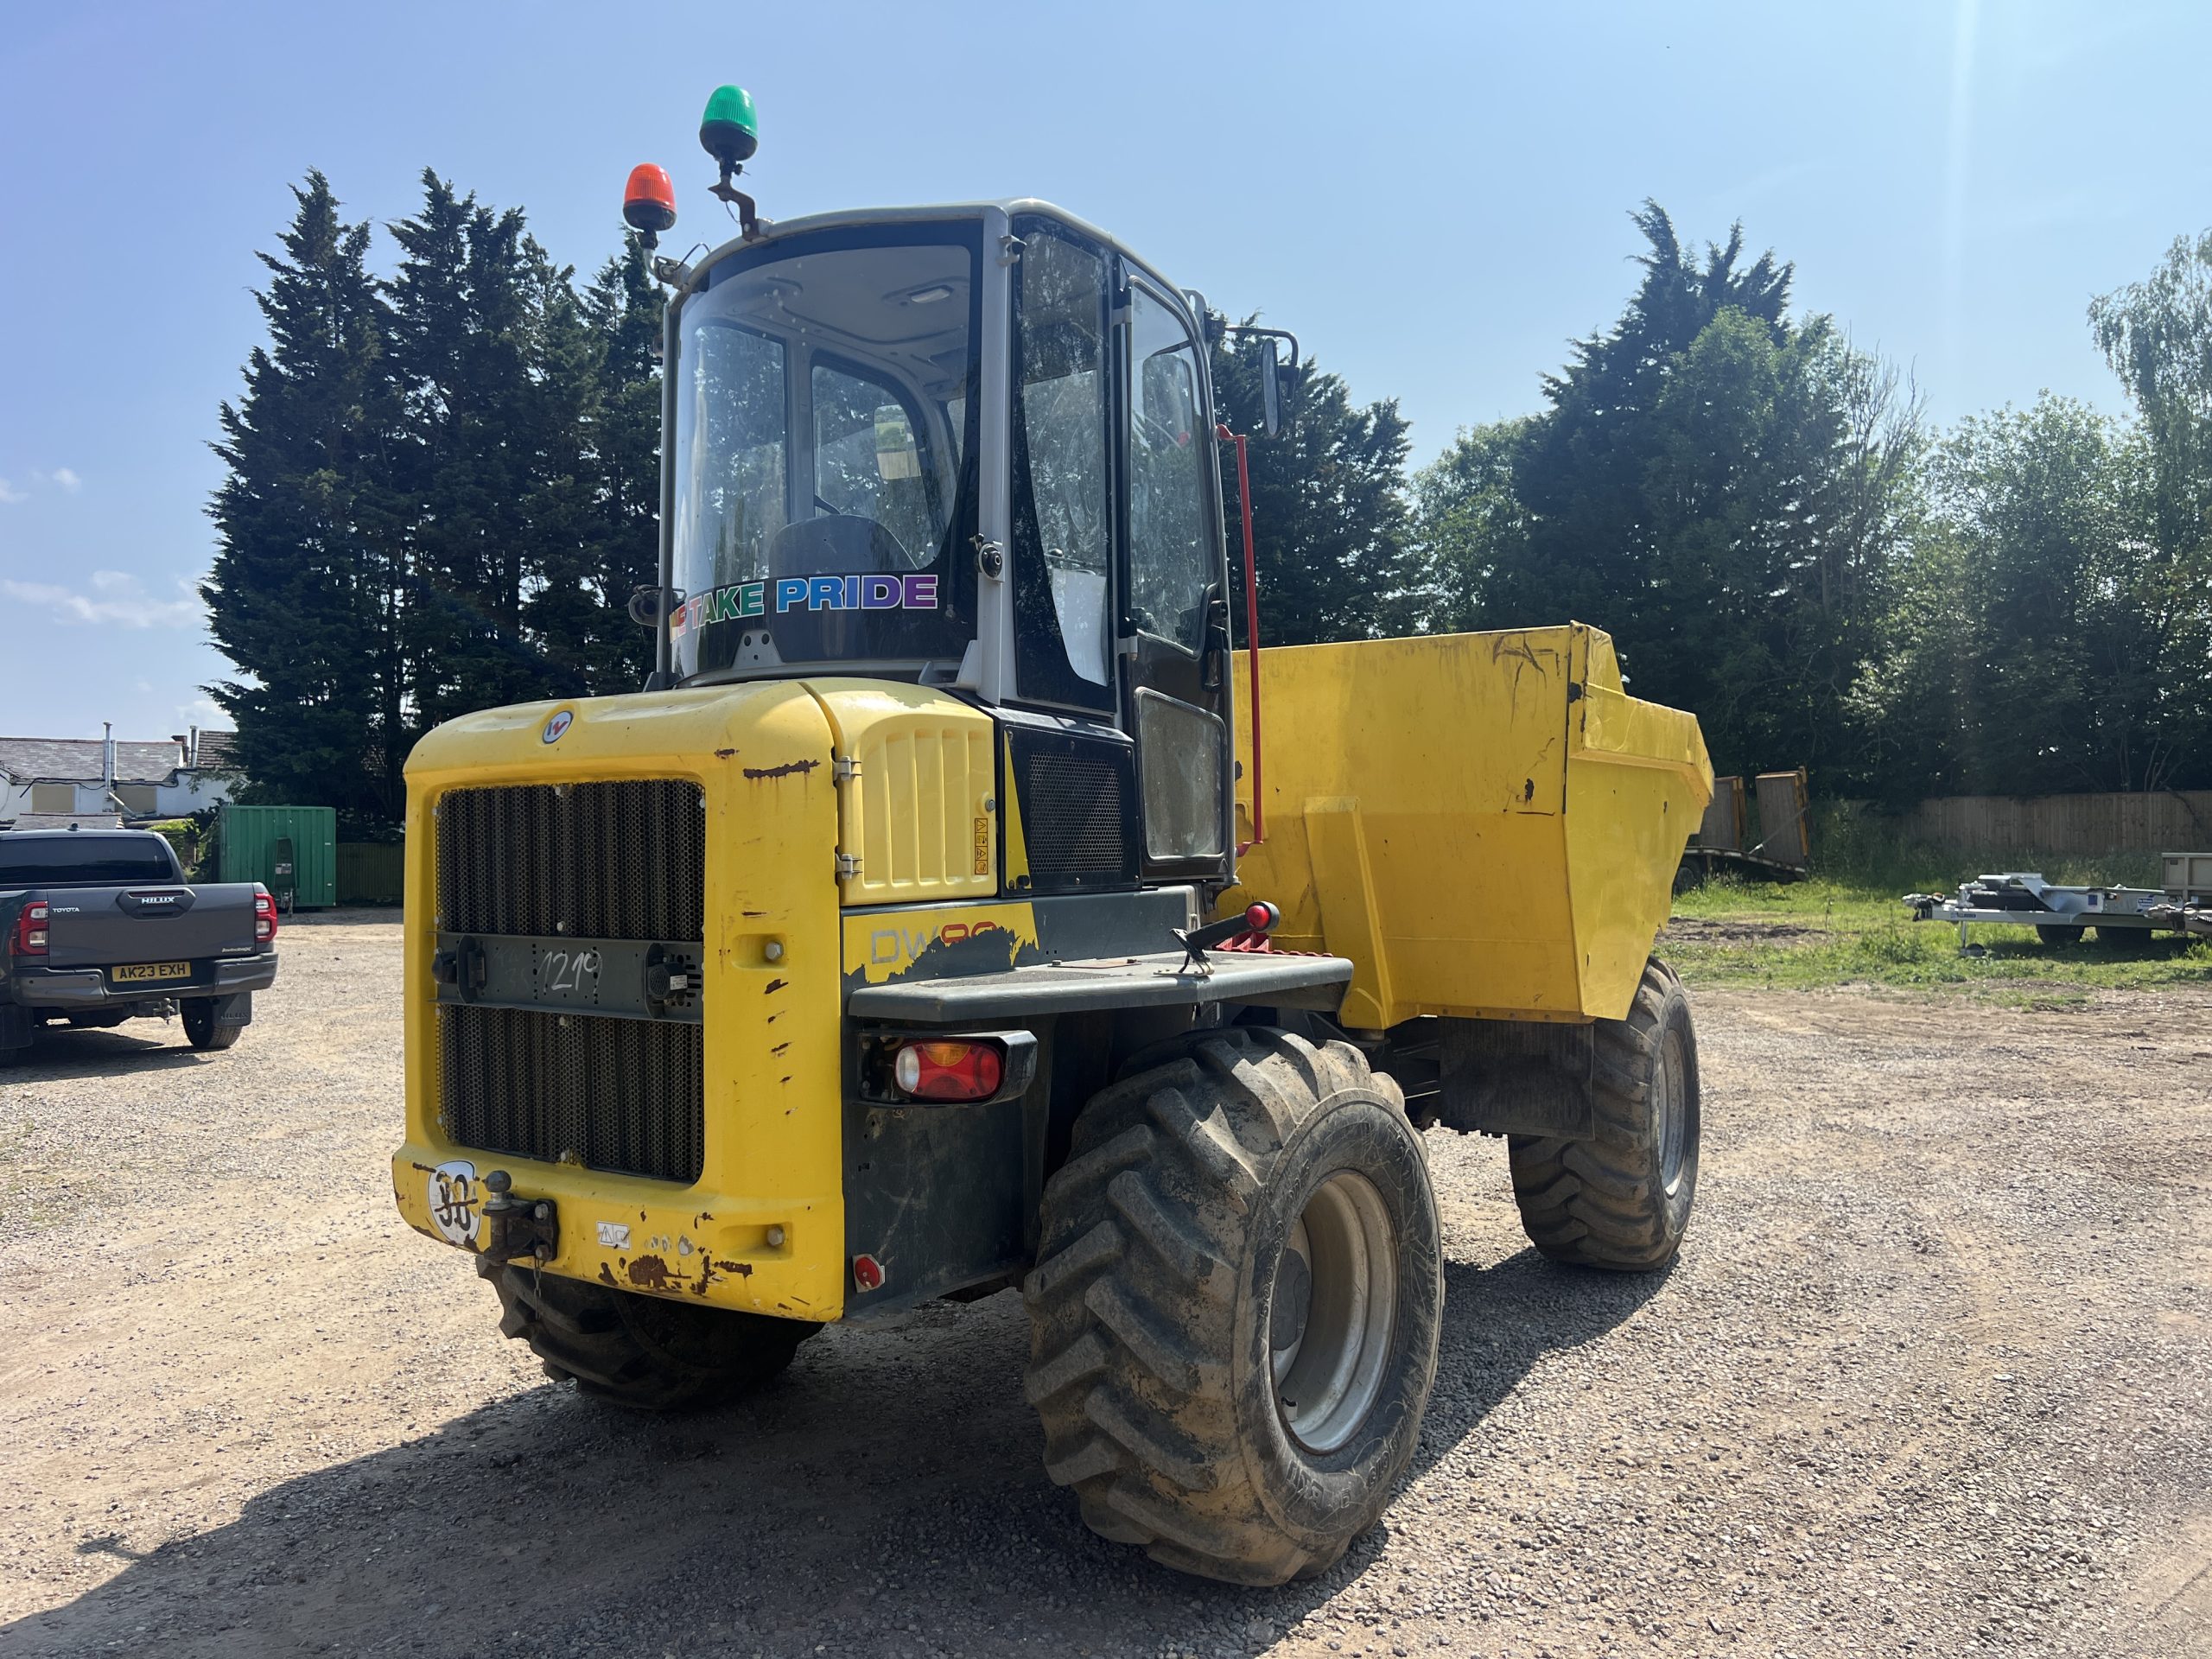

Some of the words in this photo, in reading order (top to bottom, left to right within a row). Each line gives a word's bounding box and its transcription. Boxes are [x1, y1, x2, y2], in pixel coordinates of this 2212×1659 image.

[690, 582, 765, 629] TAKE
[776, 575, 938, 613] PRIDE
[141, 896, 175, 905] HILUX
[119, 966, 156, 979] AK23
[159, 963, 186, 976] EXH
[537, 948, 603, 994] 1219
